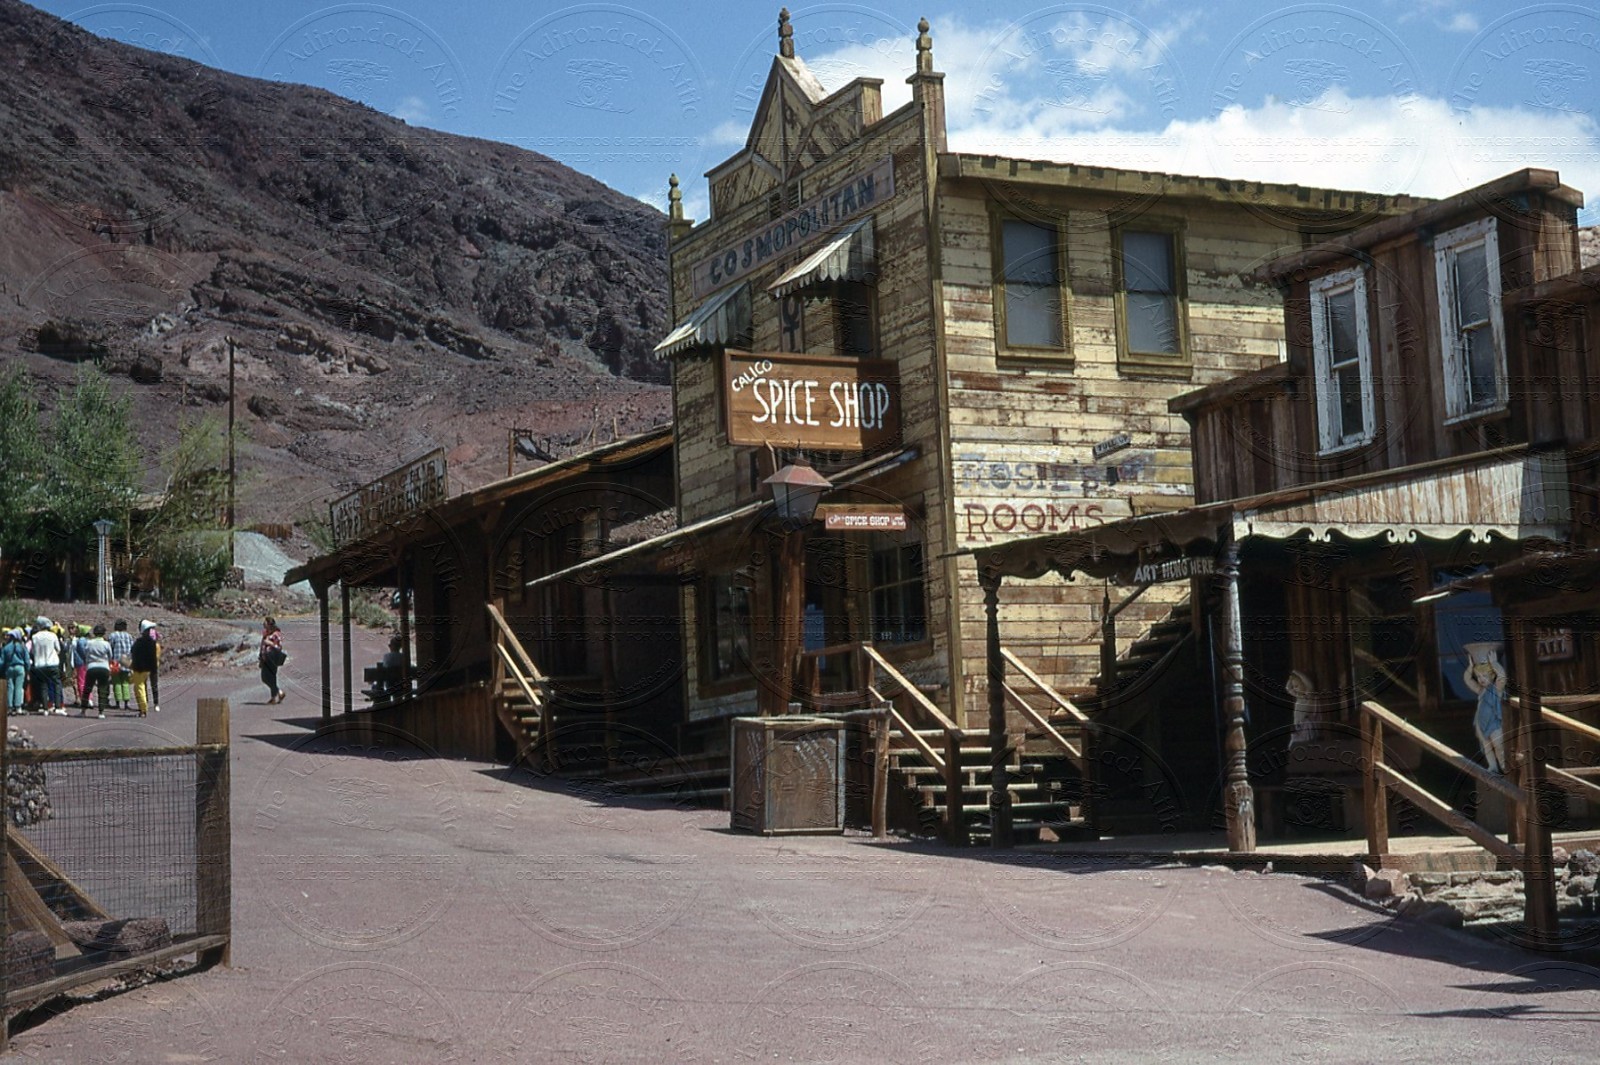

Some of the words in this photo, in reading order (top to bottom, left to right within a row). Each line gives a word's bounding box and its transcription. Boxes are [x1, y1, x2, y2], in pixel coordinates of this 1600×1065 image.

[709, 174, 875, 284] COSMOPOLITAN
[731, 359, 773, 392] CALICO
[751, 378, 820, 426] SPICE
[829, 381, 890, 430] SHOP
[845, 515, 868, 526] SPICE
[869, 515, 890, 526] SHOP
[962, 503, 1104, 542] ROOMS
[1133, 564, 1158, 583] ART
[1190, 559, 1214, 575] HERE
